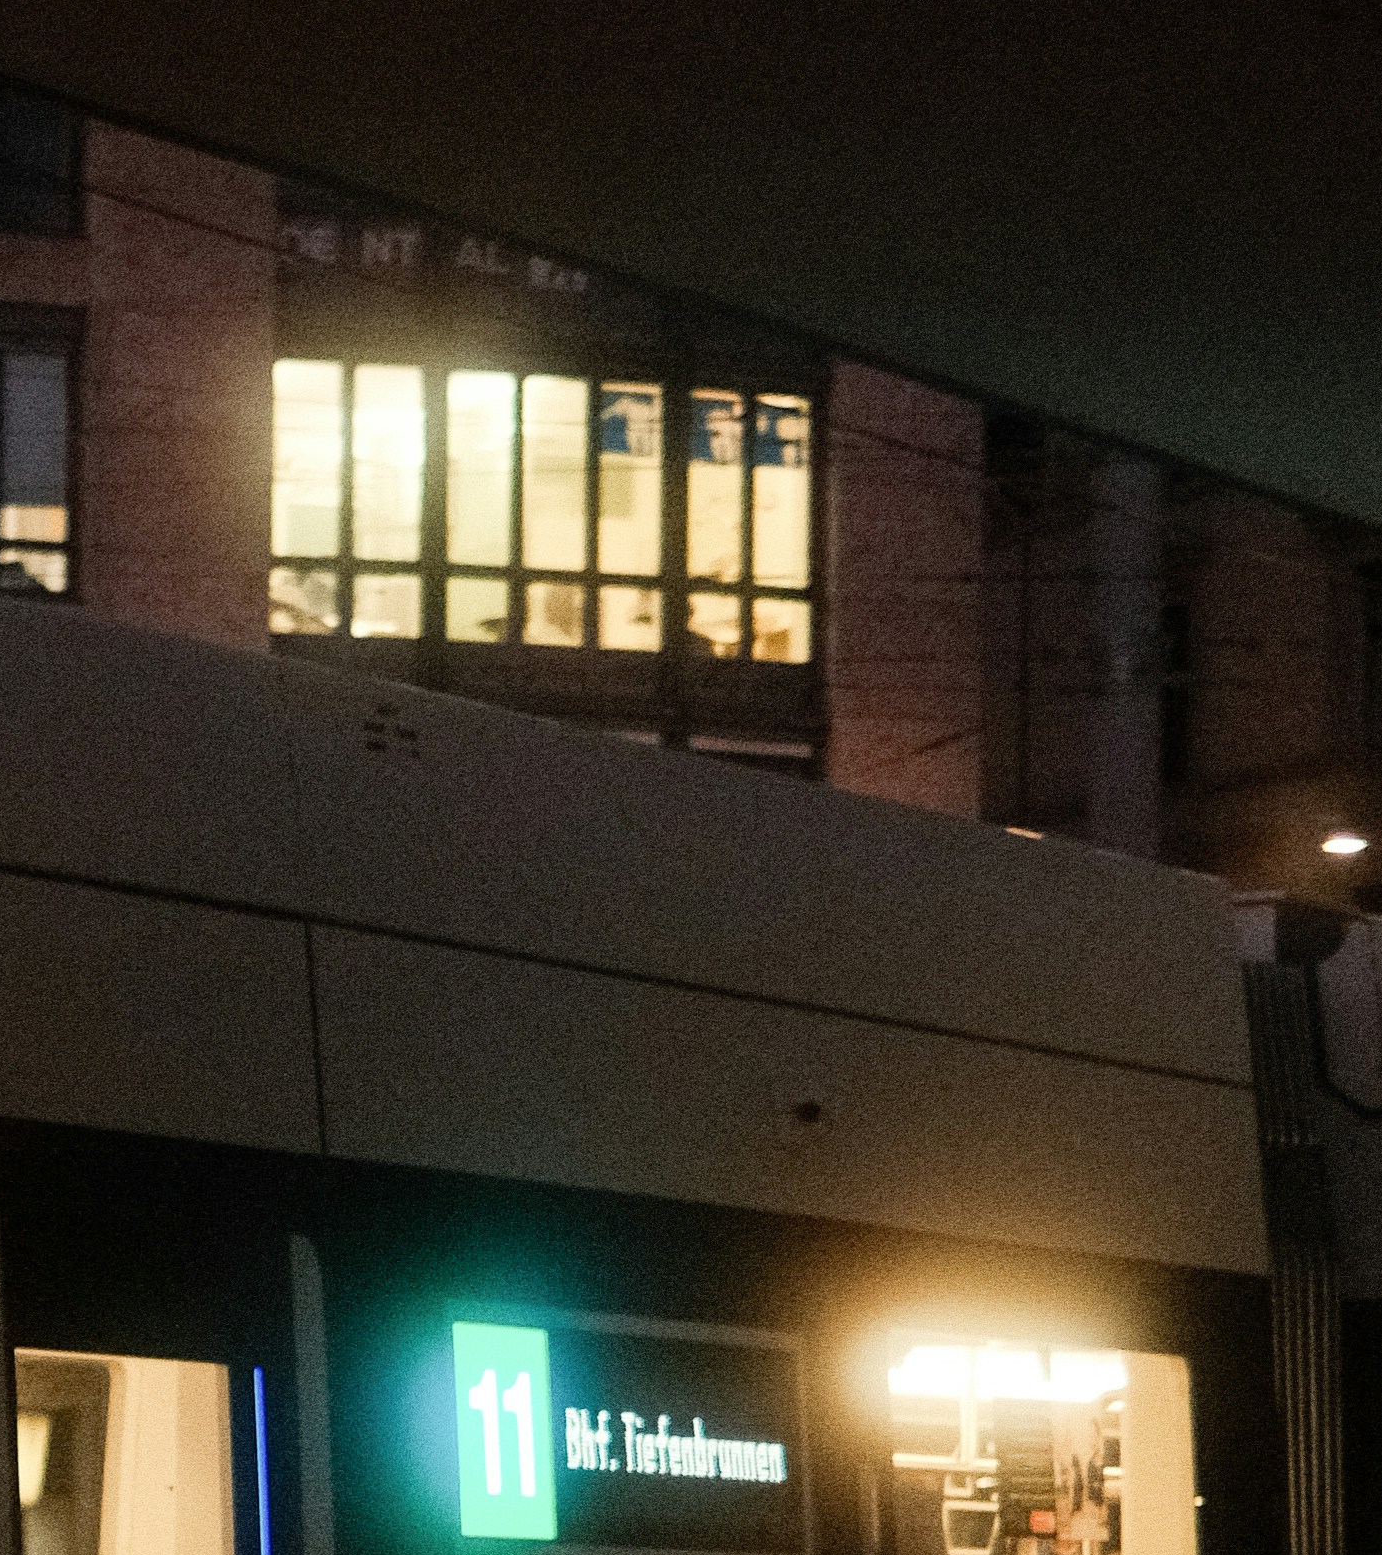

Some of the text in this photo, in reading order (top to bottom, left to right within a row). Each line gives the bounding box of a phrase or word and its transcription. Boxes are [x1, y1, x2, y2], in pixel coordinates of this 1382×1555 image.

[468, 1368, 536, 1497] 11
[564, 1407, 788, 1484] Bhf. Tiefenbrunnen
